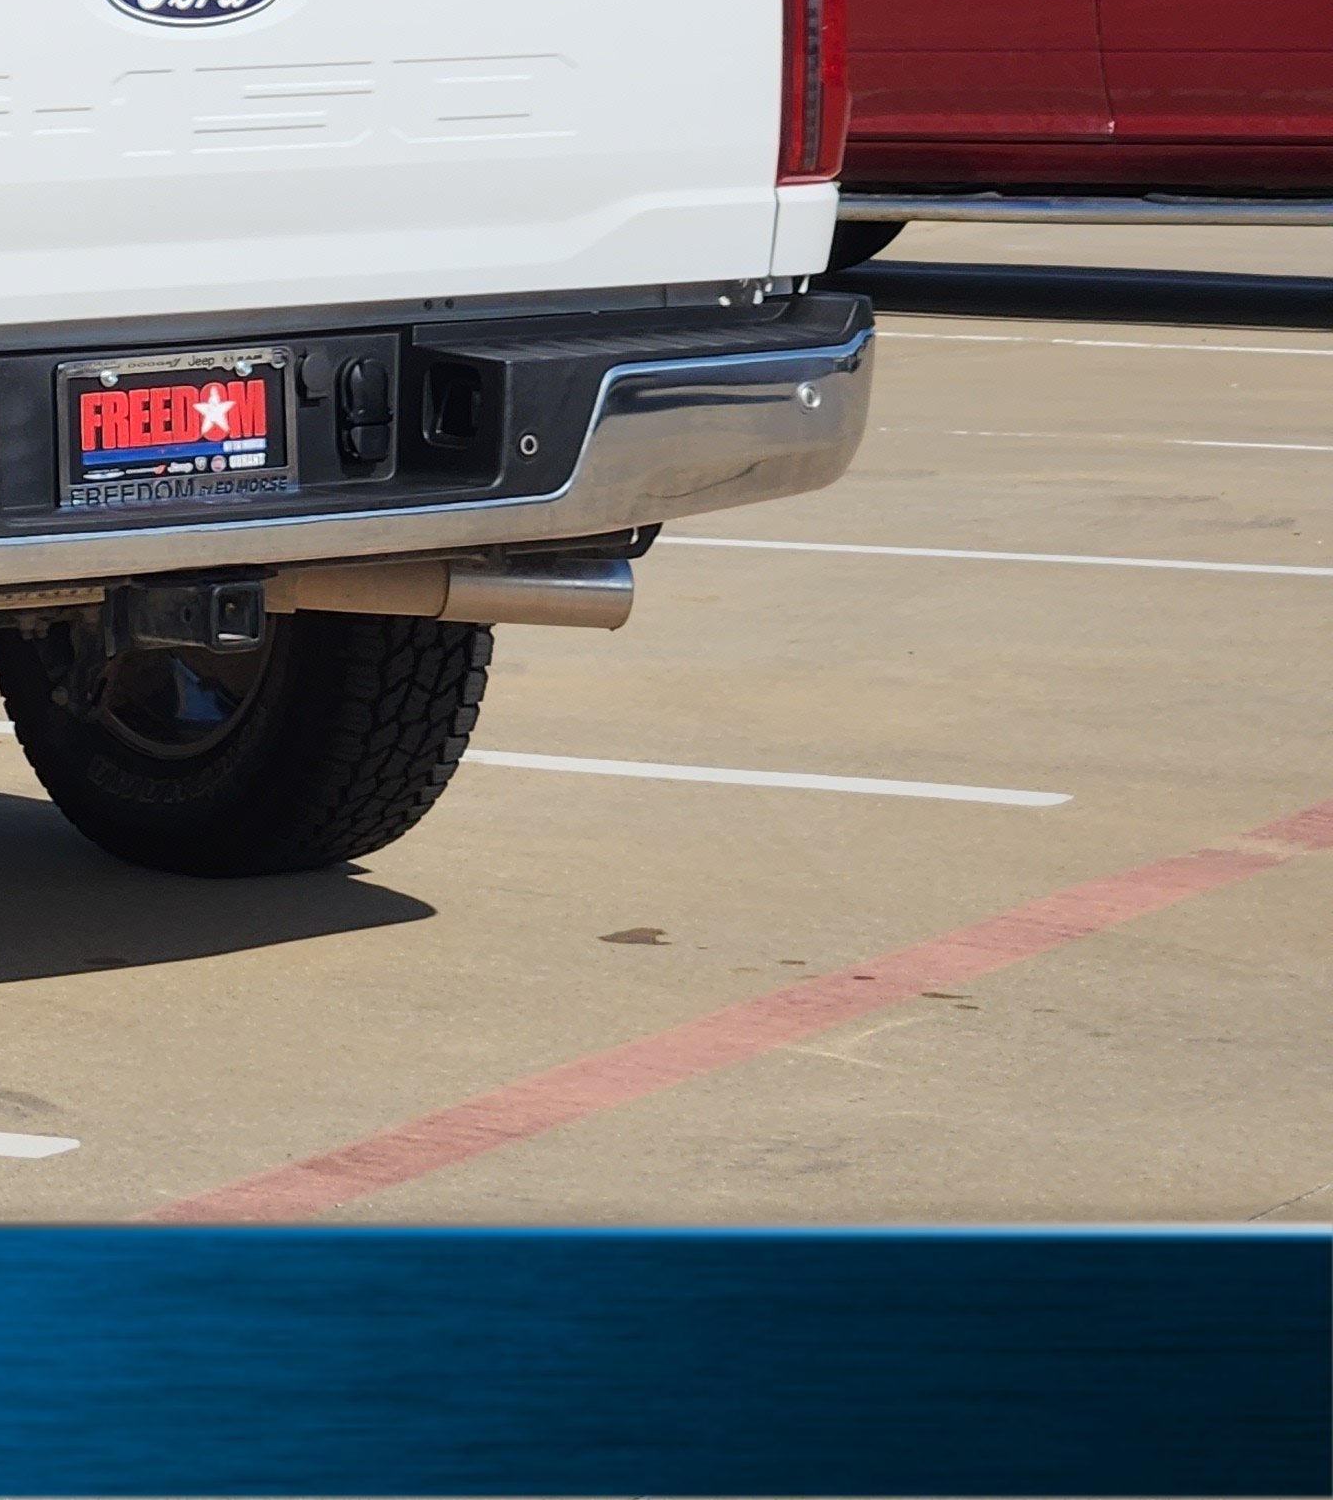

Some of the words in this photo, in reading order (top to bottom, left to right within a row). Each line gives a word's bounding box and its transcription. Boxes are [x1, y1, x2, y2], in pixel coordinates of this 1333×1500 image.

[188, 355, 215, 367] Jeep
[80, 379, 267, 451] FREEDOM
[69, 478, 196, 507] FREEDOM
